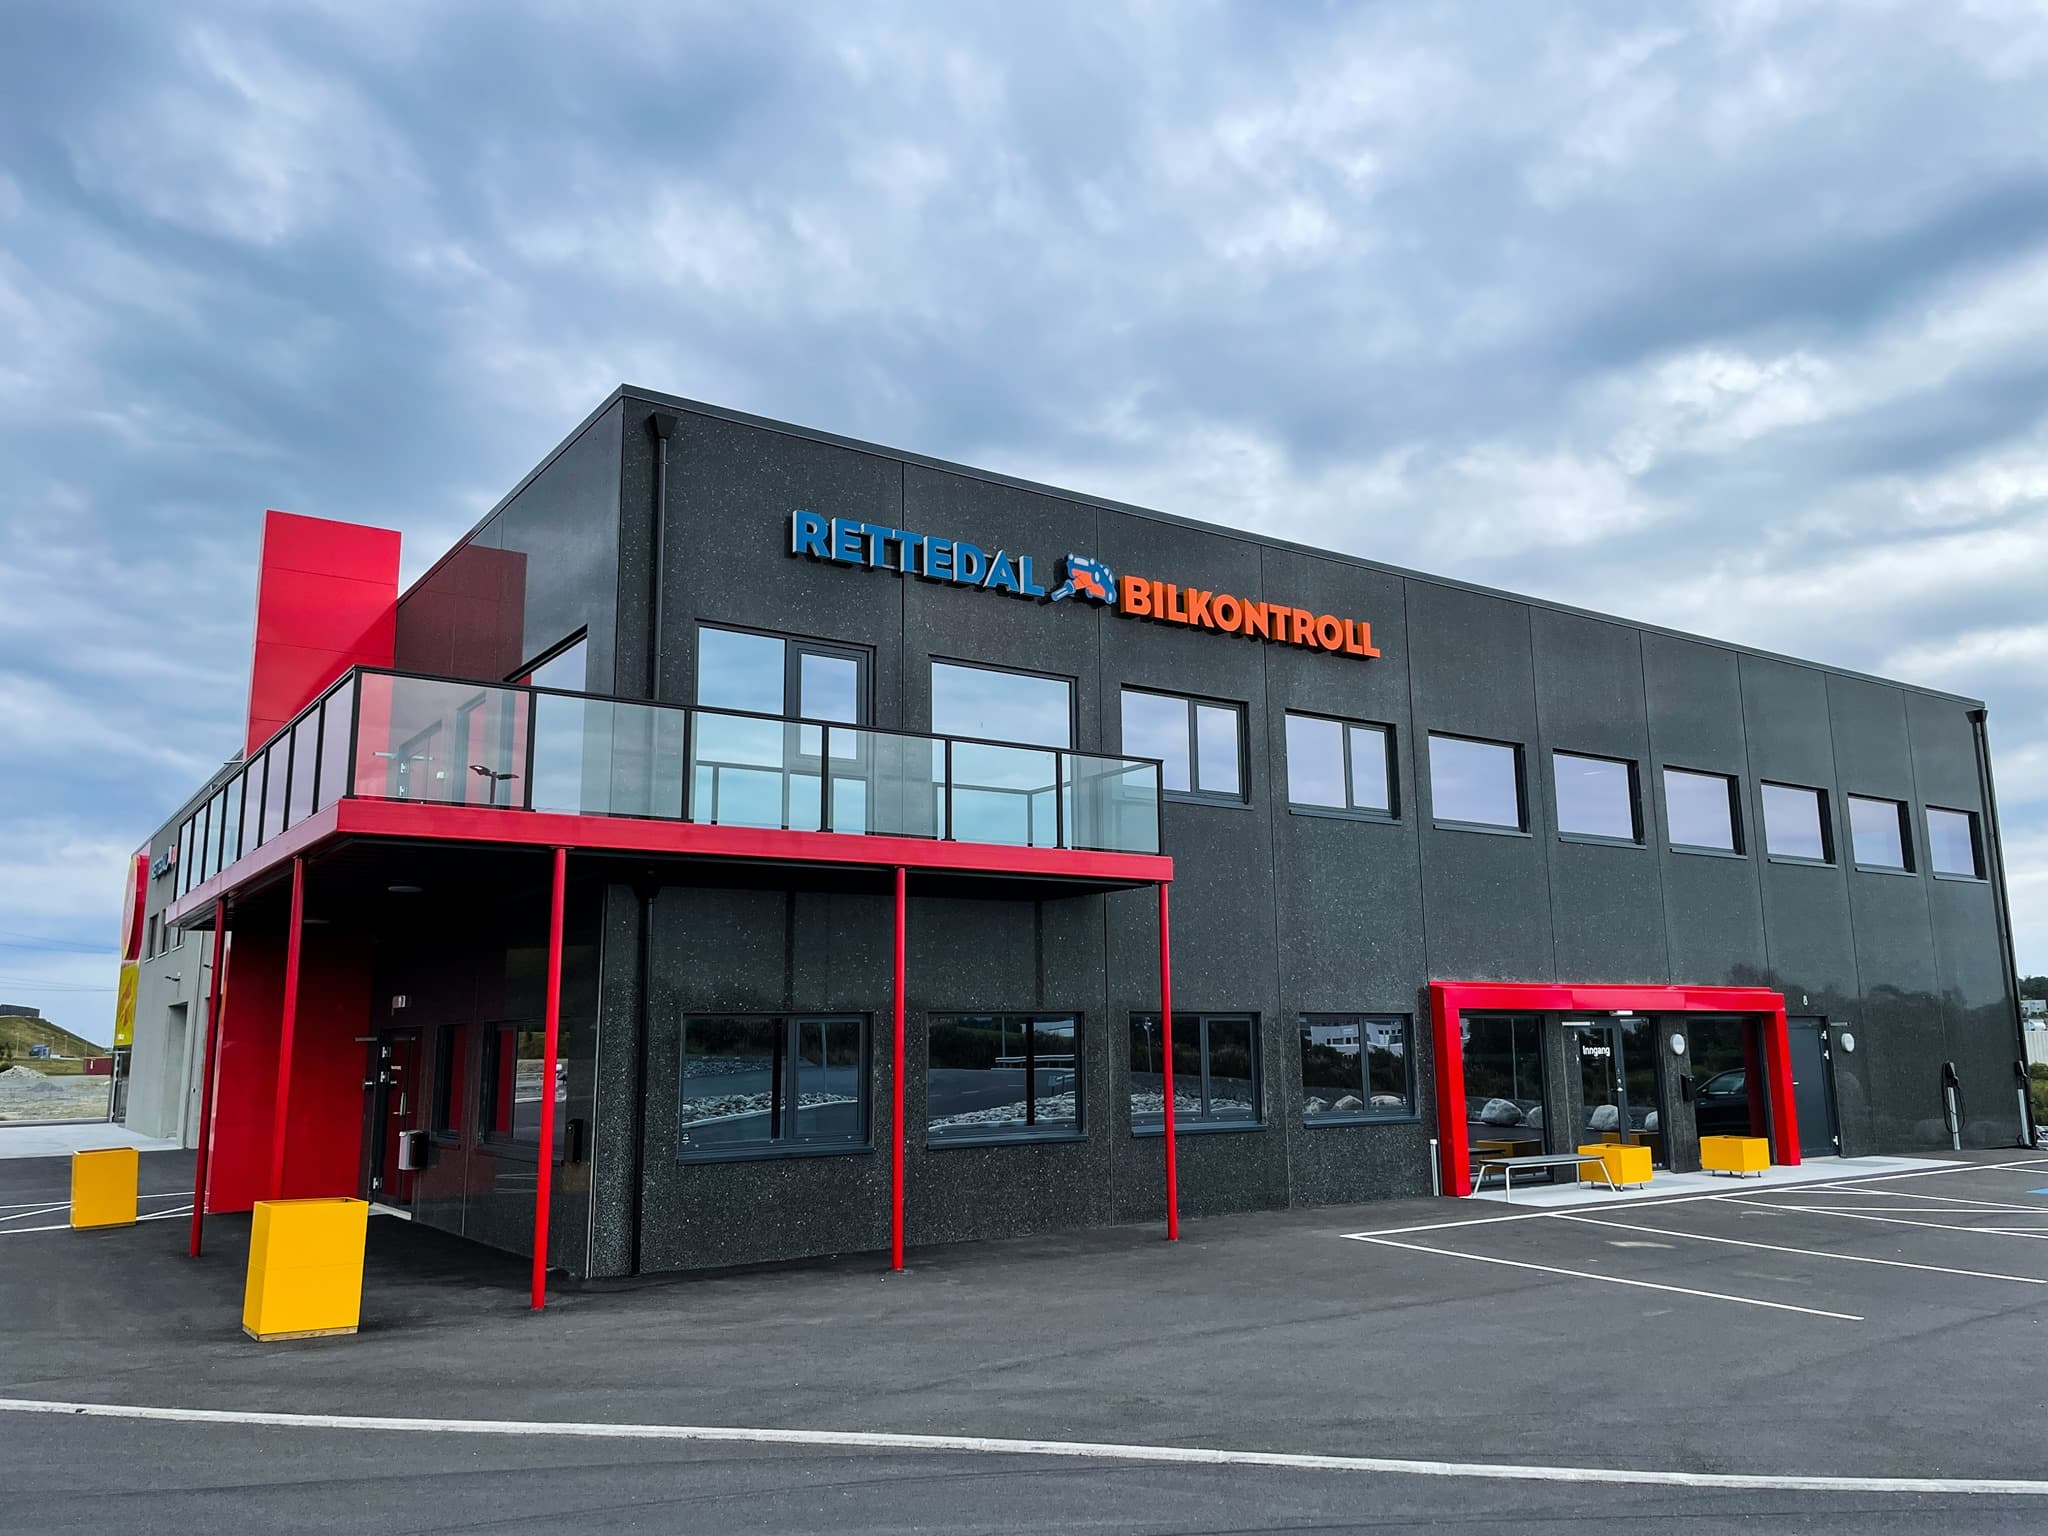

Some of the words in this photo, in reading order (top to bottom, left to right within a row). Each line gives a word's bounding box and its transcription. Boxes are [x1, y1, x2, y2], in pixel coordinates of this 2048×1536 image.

[792, 510, 1045, 597] RETTEDAL
[1120, 575, 1381, 658] BILKONTROLL
[1582, 1045, 1610, 1057] Inngang
